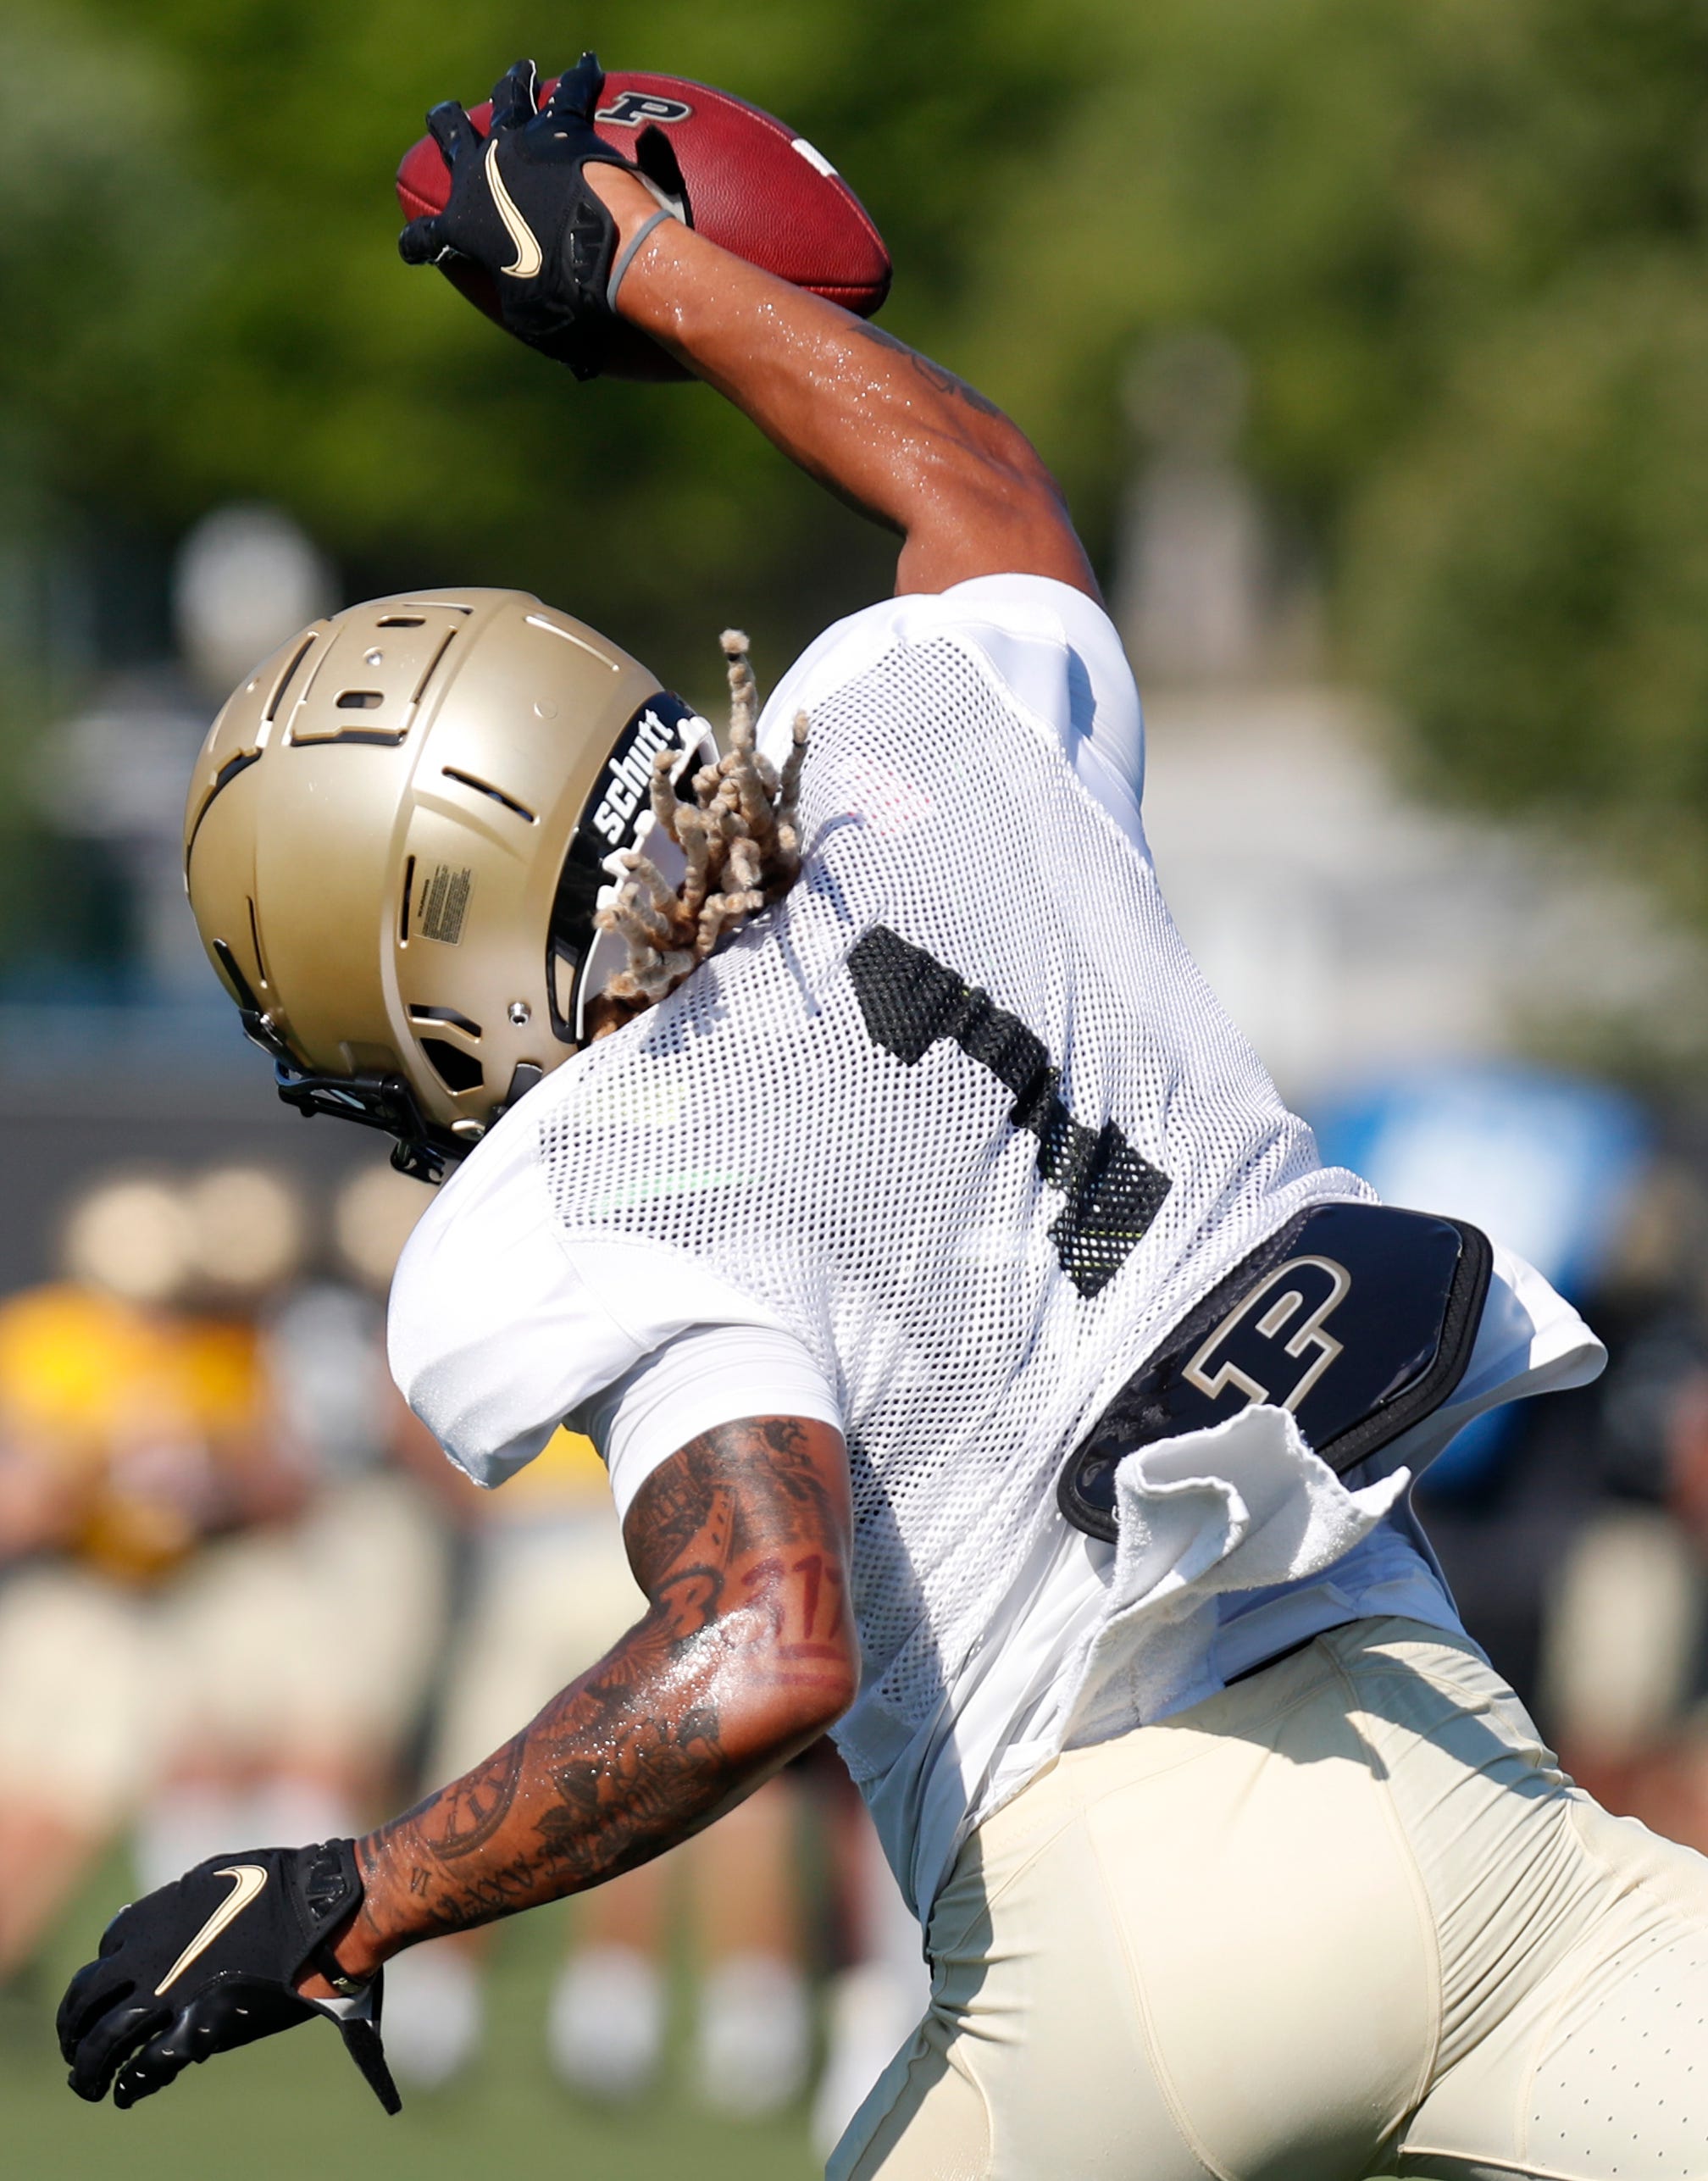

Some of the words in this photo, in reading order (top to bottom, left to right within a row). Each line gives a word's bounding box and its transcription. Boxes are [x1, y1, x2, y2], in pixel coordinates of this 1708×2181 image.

[595, 91, 694, 128] P
[847, 922, 1173, 1300] 1
[1181, 1254, 1352, 1413] P
